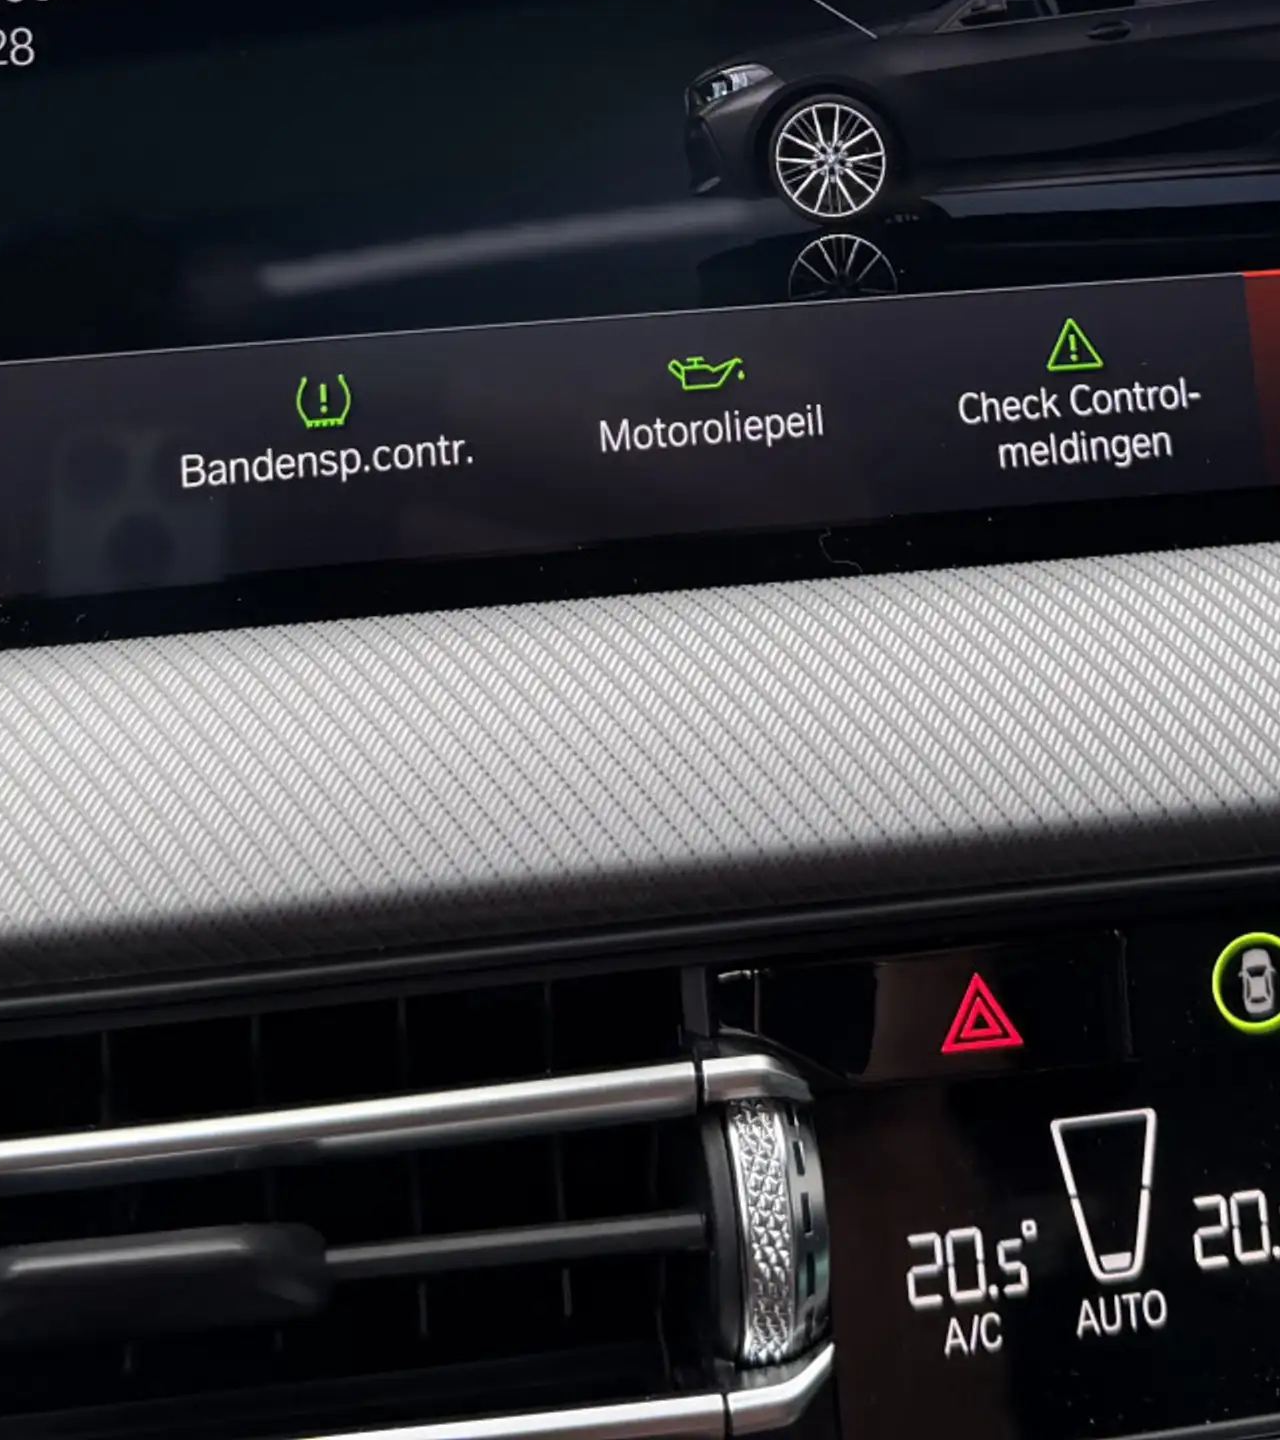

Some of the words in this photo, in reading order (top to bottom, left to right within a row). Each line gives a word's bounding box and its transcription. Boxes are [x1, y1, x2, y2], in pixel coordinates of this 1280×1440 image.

[958, 384, 1059, 425] Check
[1069, 377, 1202, 416] Control-
[598, 404, 824, 453] Motoroliepeil
[997, 427, 1173, 469] meldingen
[181, 433, 475, 488] Bandensp.contr.
[944, 1311, 1004, 1358] A/C
[1076, 1289, 1168, 1339] AUTO
